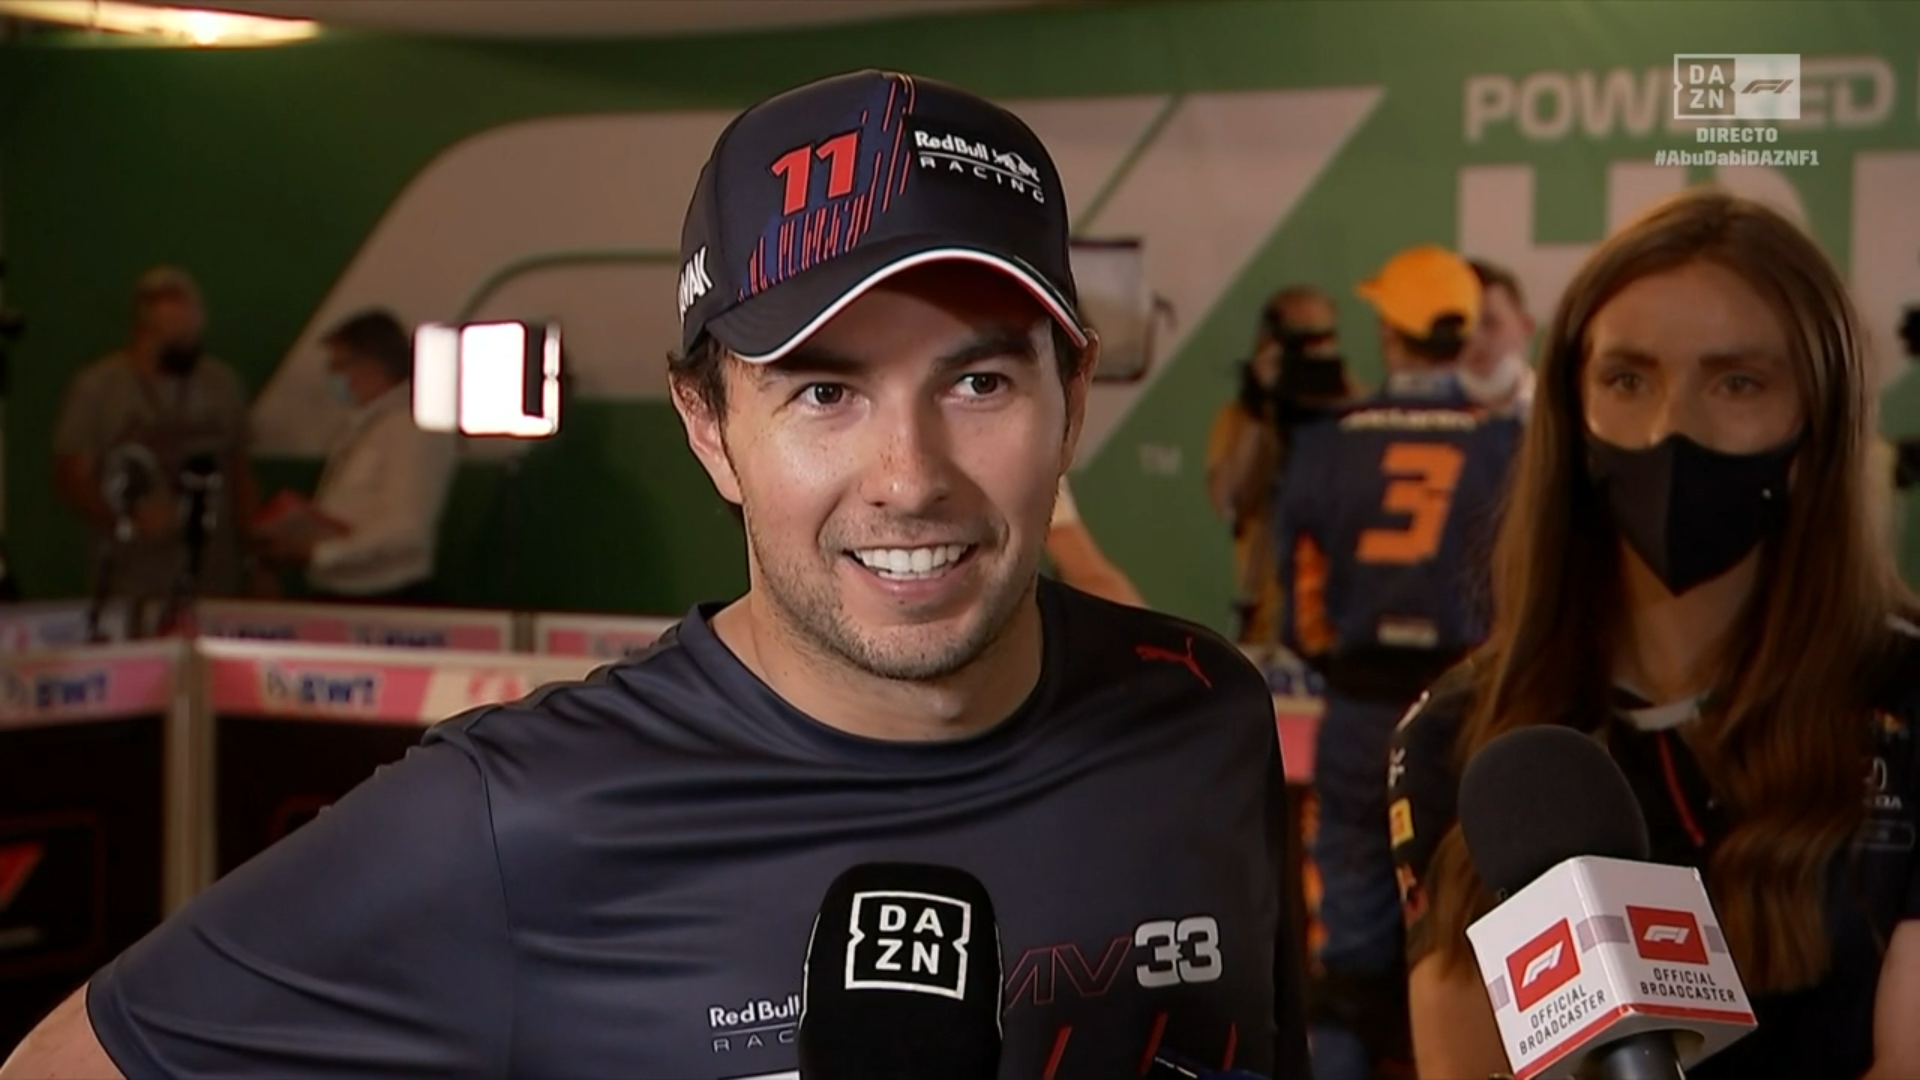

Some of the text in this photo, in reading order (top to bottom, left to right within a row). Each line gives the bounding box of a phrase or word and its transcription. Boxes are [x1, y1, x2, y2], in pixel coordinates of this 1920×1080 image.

[771, 131, 859, 217] 11
[920, 156, 1045, 204] RACING
[1356, 442, 1466, 565] 3
[1640, 981, 1736, 1003] BROADCASTER
[1653, 967, 1716, 986] OFFICIAL
[1519, 989, 1606, 1055] BROADCASTER
[1530, 984, 1587, 1030] OFFICIAL
[712, 1028, 797, 1053] RAC
